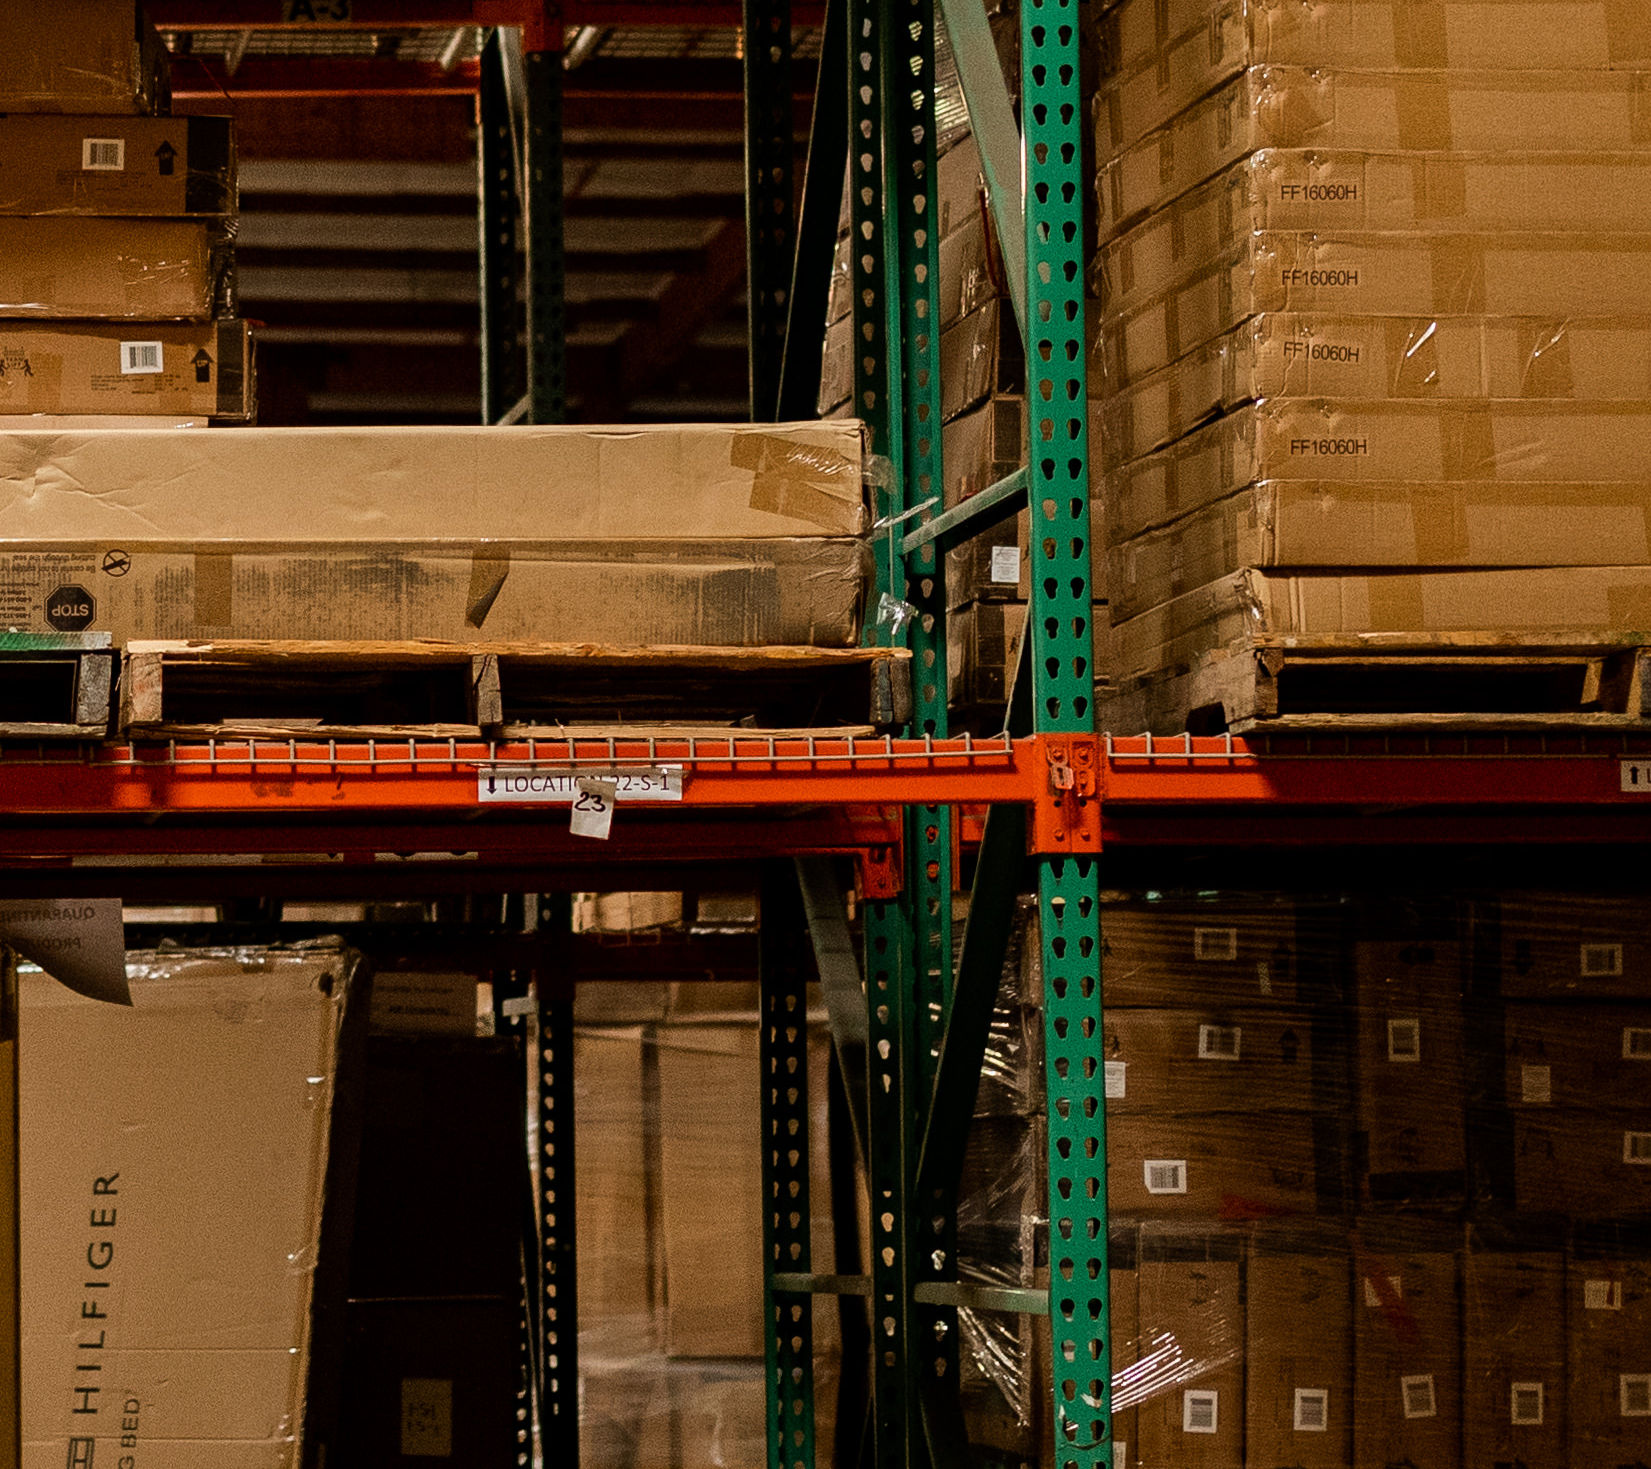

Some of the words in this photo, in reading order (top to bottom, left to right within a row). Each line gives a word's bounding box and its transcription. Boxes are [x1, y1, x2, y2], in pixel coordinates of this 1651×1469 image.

[1280, 183, 1357, 200] FF16060H
[1282, 269, 1358, 286] FF16060H
[1284, 341, 1359, 363] FF16060H
[1290, 439, 1366, 455] FF16060H
[51, 603, 89, 617] STOP
[573, 791, 607, 812] 23
[72, 1172, 120, 1416] HILFIGER
[121, 1398, 140, 1449] BED
